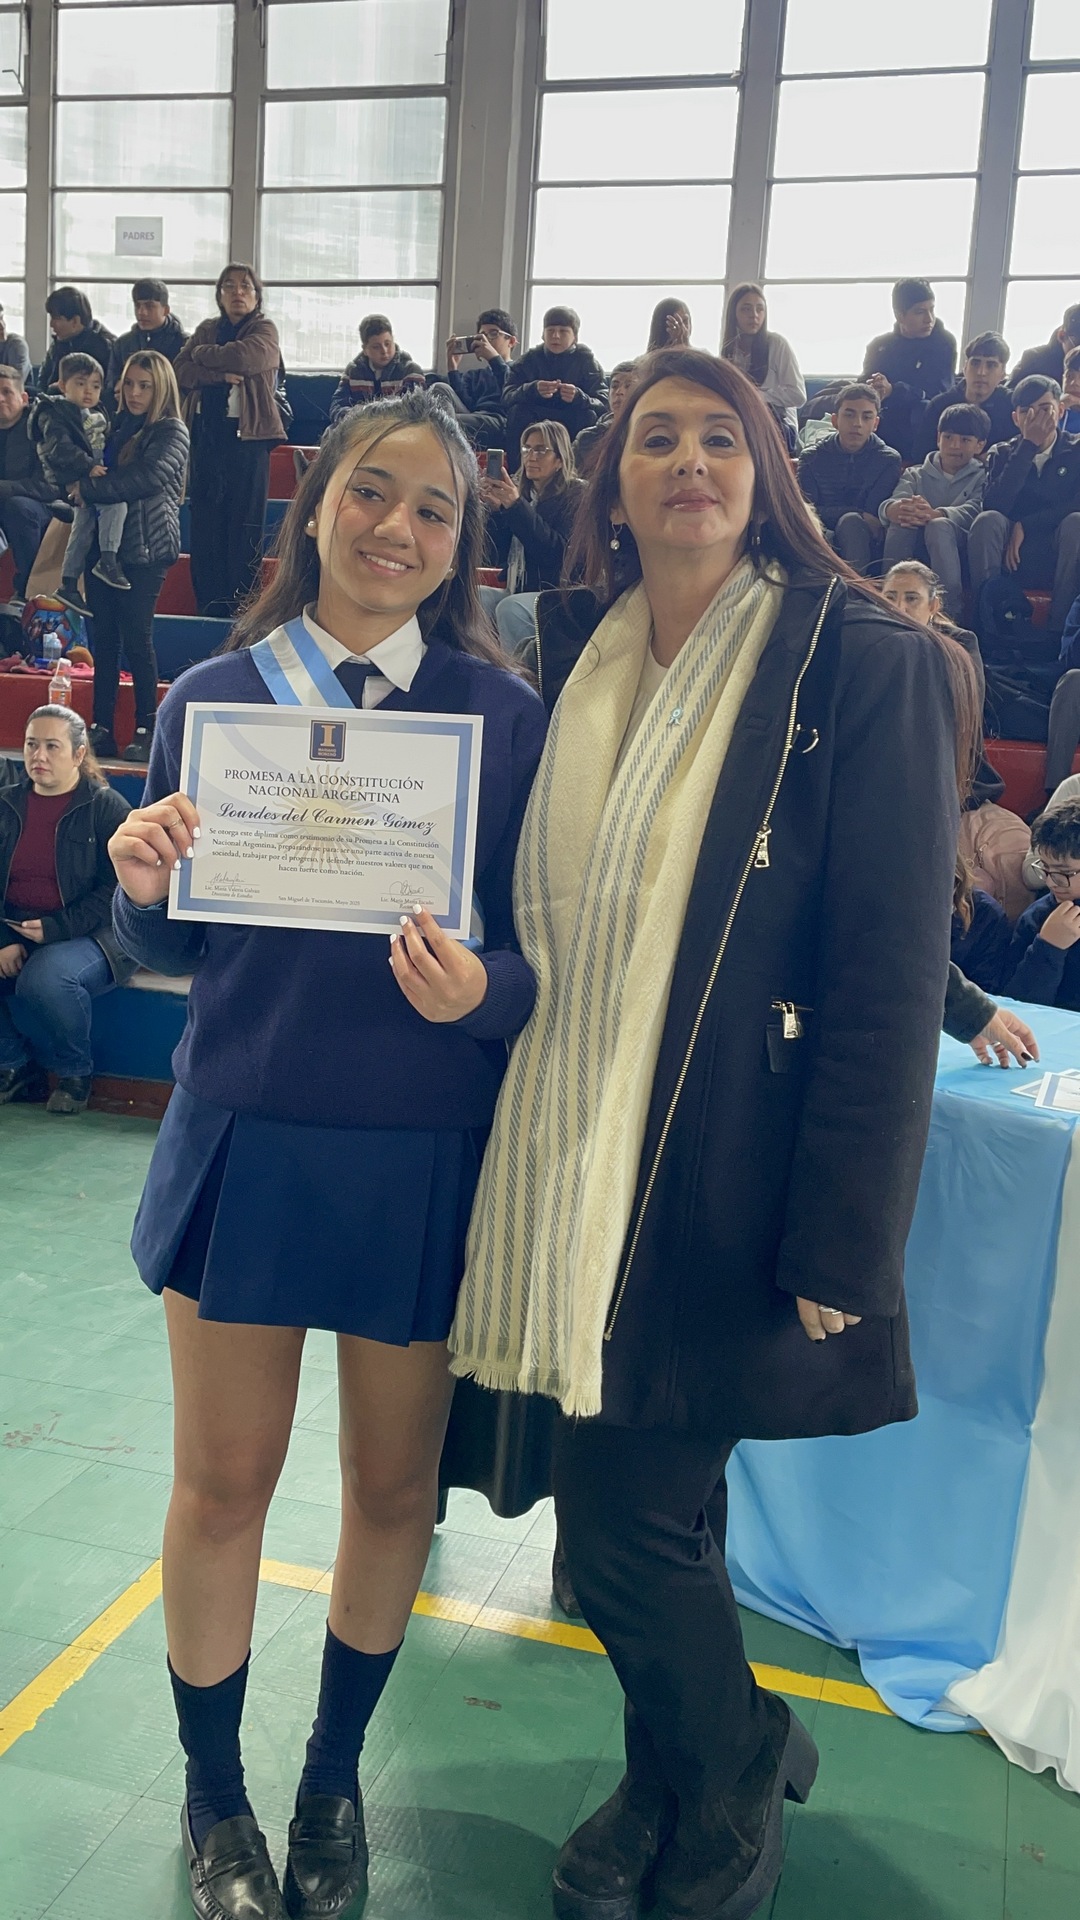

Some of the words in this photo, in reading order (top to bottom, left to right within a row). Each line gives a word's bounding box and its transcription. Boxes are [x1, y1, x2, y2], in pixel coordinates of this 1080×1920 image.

[122, 232, 155, 240] PADRES
[225, 769, 283, 782] PROMESA
[287, 773, 296, 783] A
[300, 773, 316, 784] LA
[320, 775, 424, 790] CONSTITUCIÓN
[248, 785, 318, 799] NACIONAL
[322, 789, 400, 803] ARGENTINA
[217, 803, 280, 820] Lourdes
[282, 806, 309, 822] del
[312, 809, 378, 826] Carmen
[382, 813, 436, 835] Gómez
[242, 841, 276, 849] Argentina,
[355, 836, 382, 844] Promesa
[397, 840, 439, 848] Constitución
[242, 852, 267, 860] trabajar
[326, 856, 354, 865] defender
